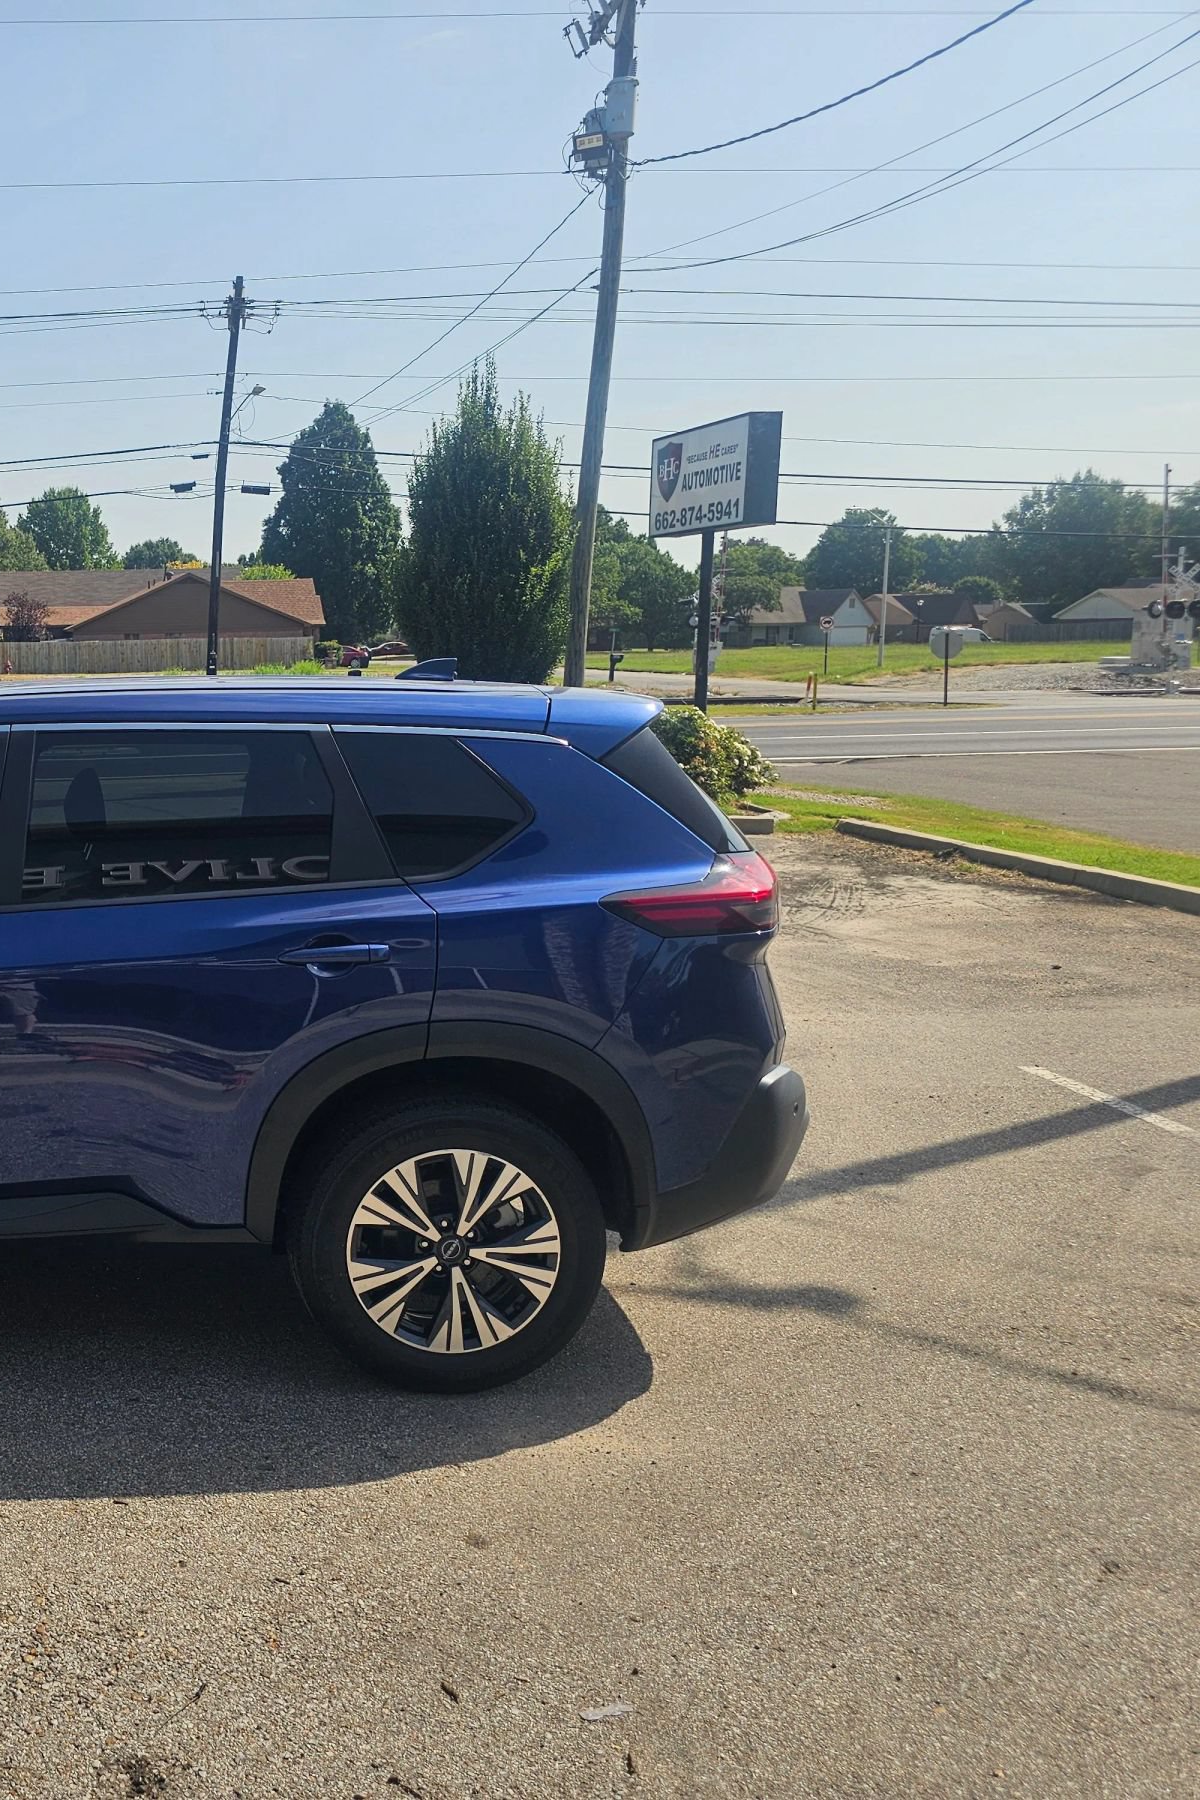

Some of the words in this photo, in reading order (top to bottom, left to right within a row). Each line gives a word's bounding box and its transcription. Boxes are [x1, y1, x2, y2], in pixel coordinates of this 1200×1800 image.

[709, 443, 720, 460] HE
[681, 461, 741, 492] AUTOMOTIVE
[654, 498, 740, 531] 662-874-5941
